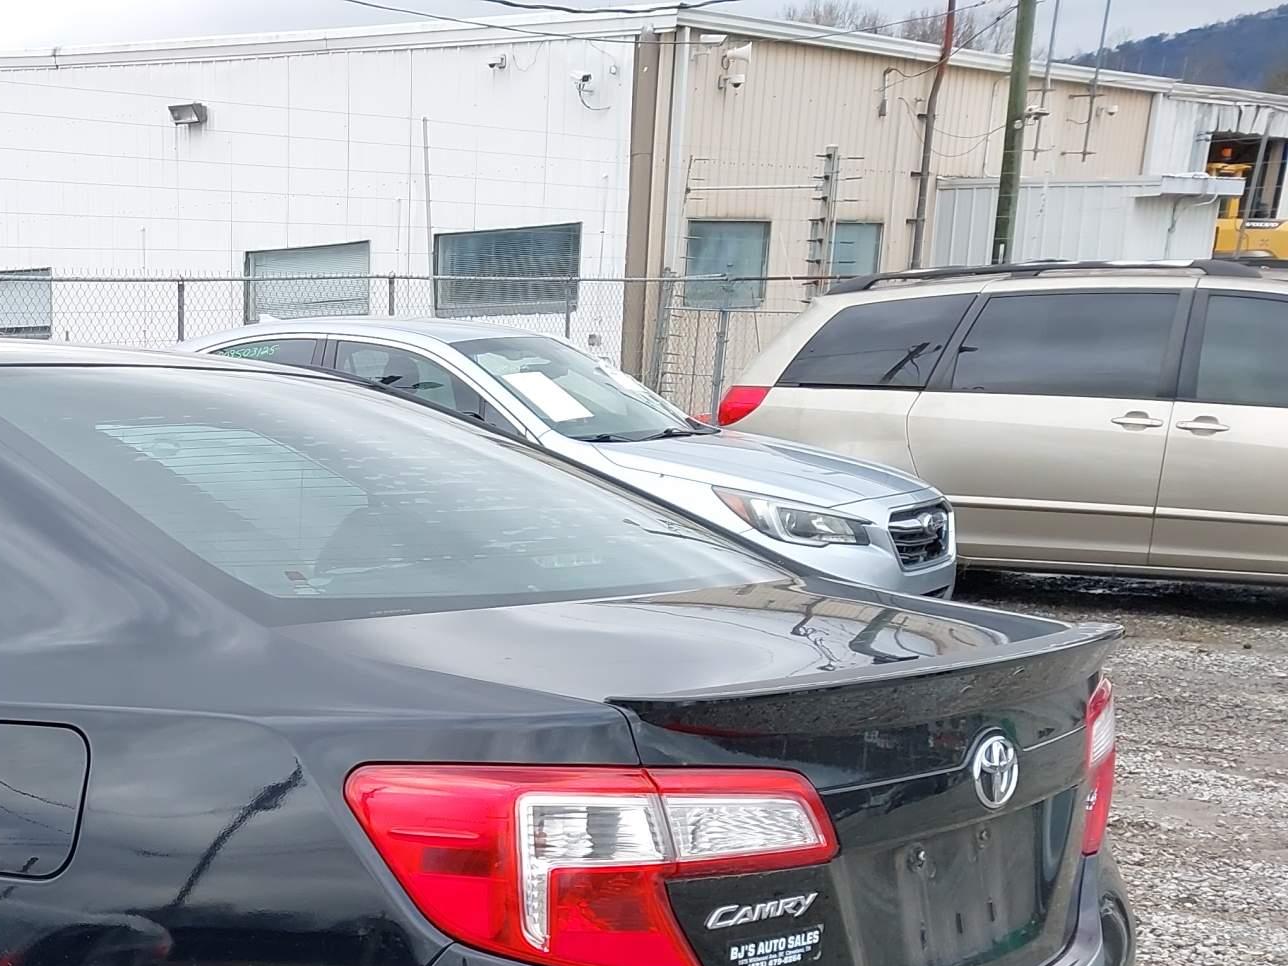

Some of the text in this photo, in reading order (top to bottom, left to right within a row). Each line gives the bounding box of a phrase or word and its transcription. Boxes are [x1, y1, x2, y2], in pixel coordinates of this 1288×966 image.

[705, 892, 819, 930] CAMRY
[729, 943, 756, 961] BJ'S
[756, 937, 786, 956] AUTO
[787, 930, 820, 949] SALES
